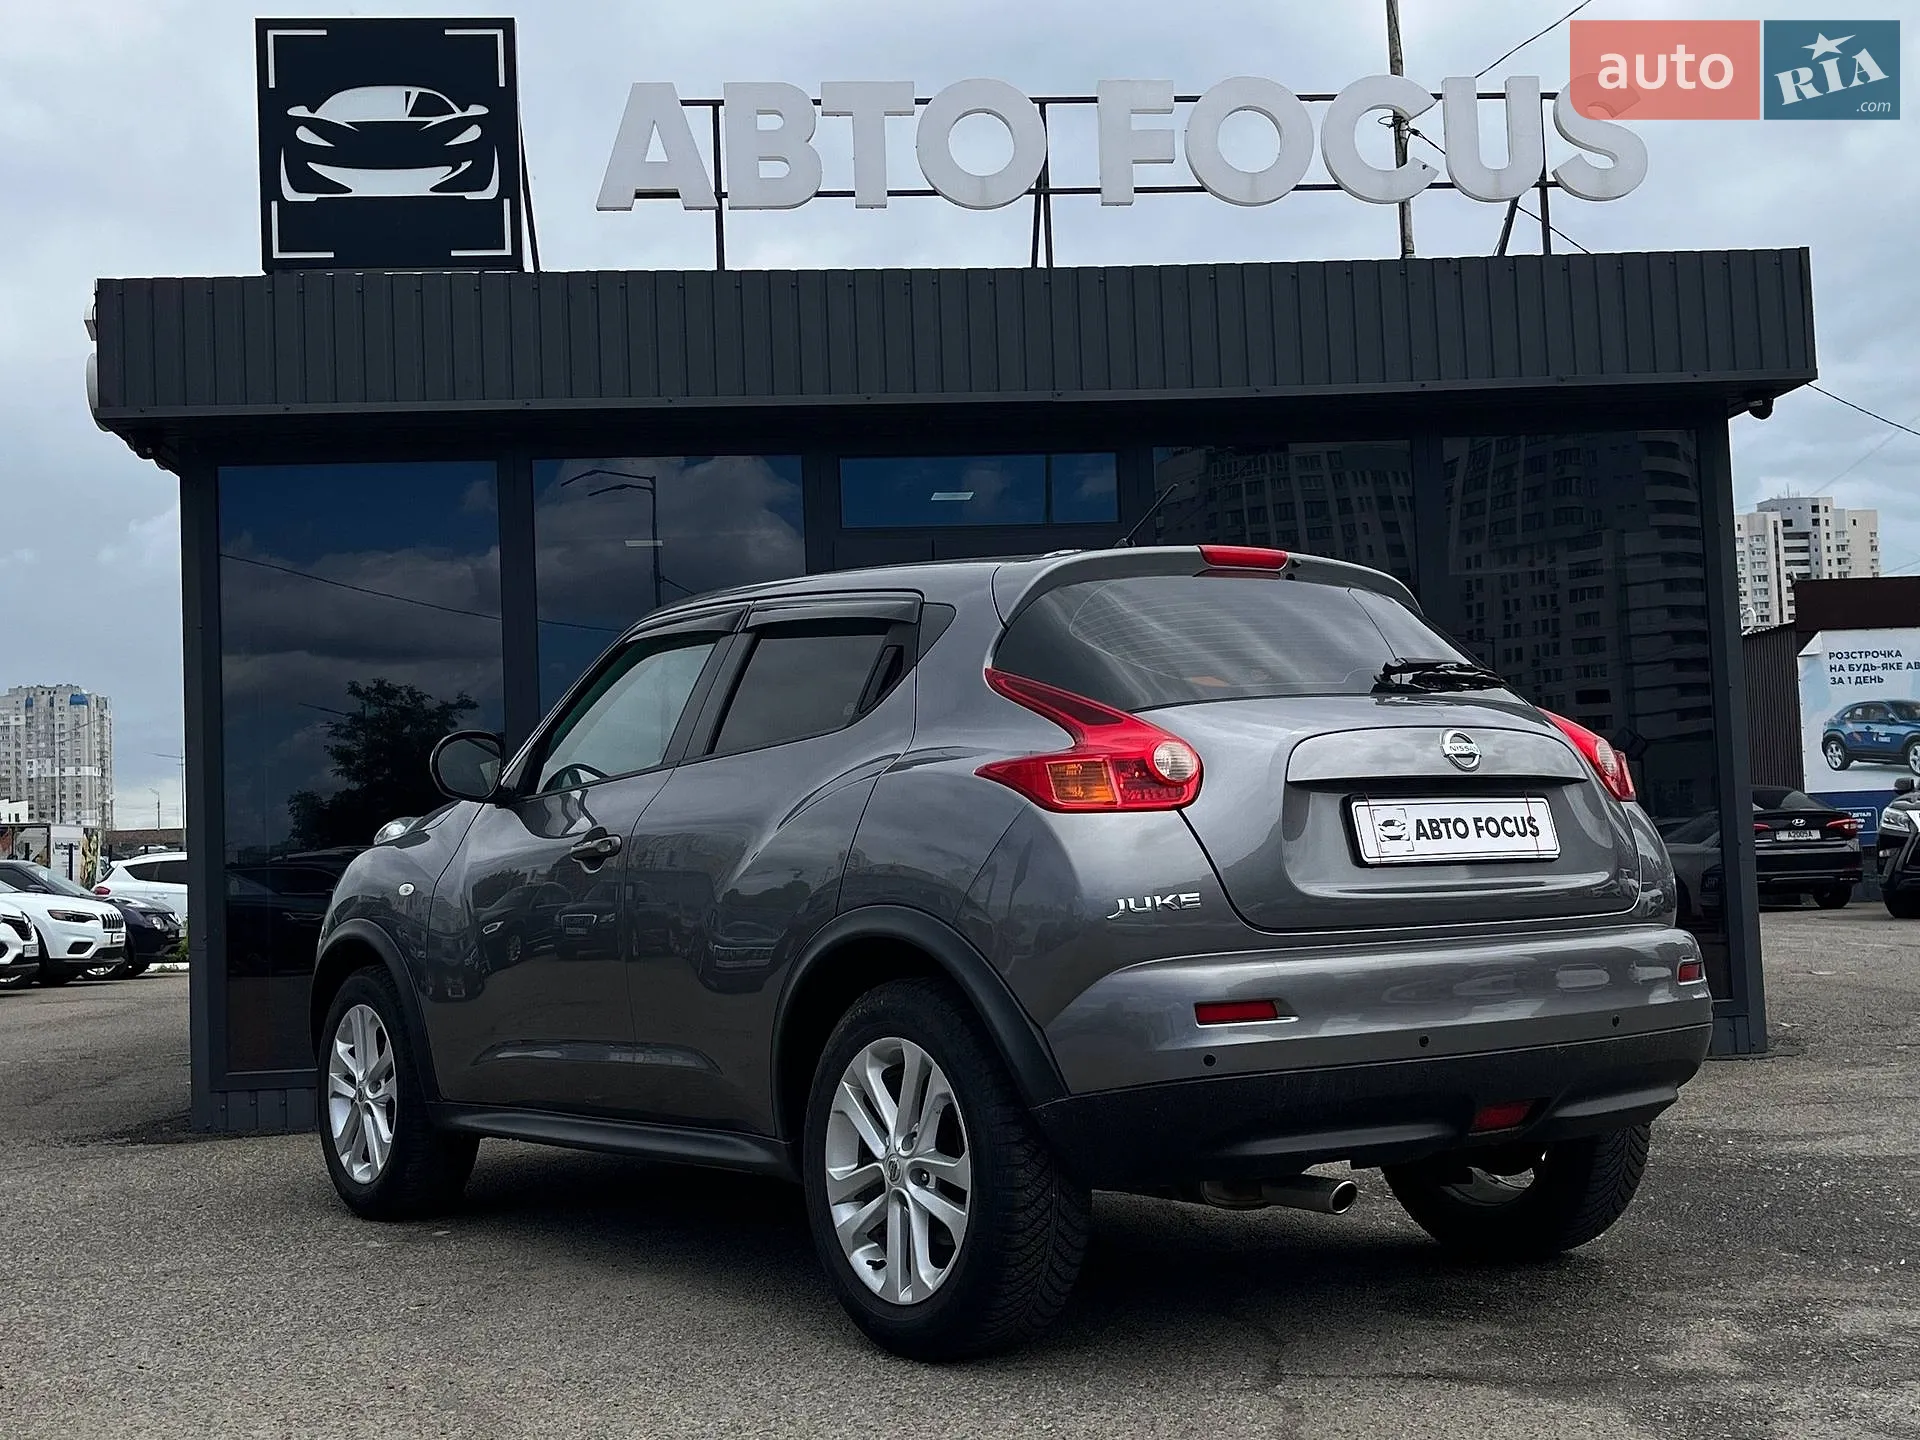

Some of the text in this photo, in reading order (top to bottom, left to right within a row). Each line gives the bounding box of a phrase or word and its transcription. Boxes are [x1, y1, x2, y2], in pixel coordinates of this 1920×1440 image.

[596, 74, 1648, 212] АВТО FOCUS
[1828, 650, 1903, 660] РОЗСТРОЧКА
[1829, 664, 1846, 672] НА
[1848, 662, 1903, 672] БУДЬ-ЯКЕ
[1830, 675, 1885, 685] ЗА 1 ДЕНЬ
[1415, 816, 1540, 841] АВТО FOCUS
[1105, 892, 1201, 920] JUKE
